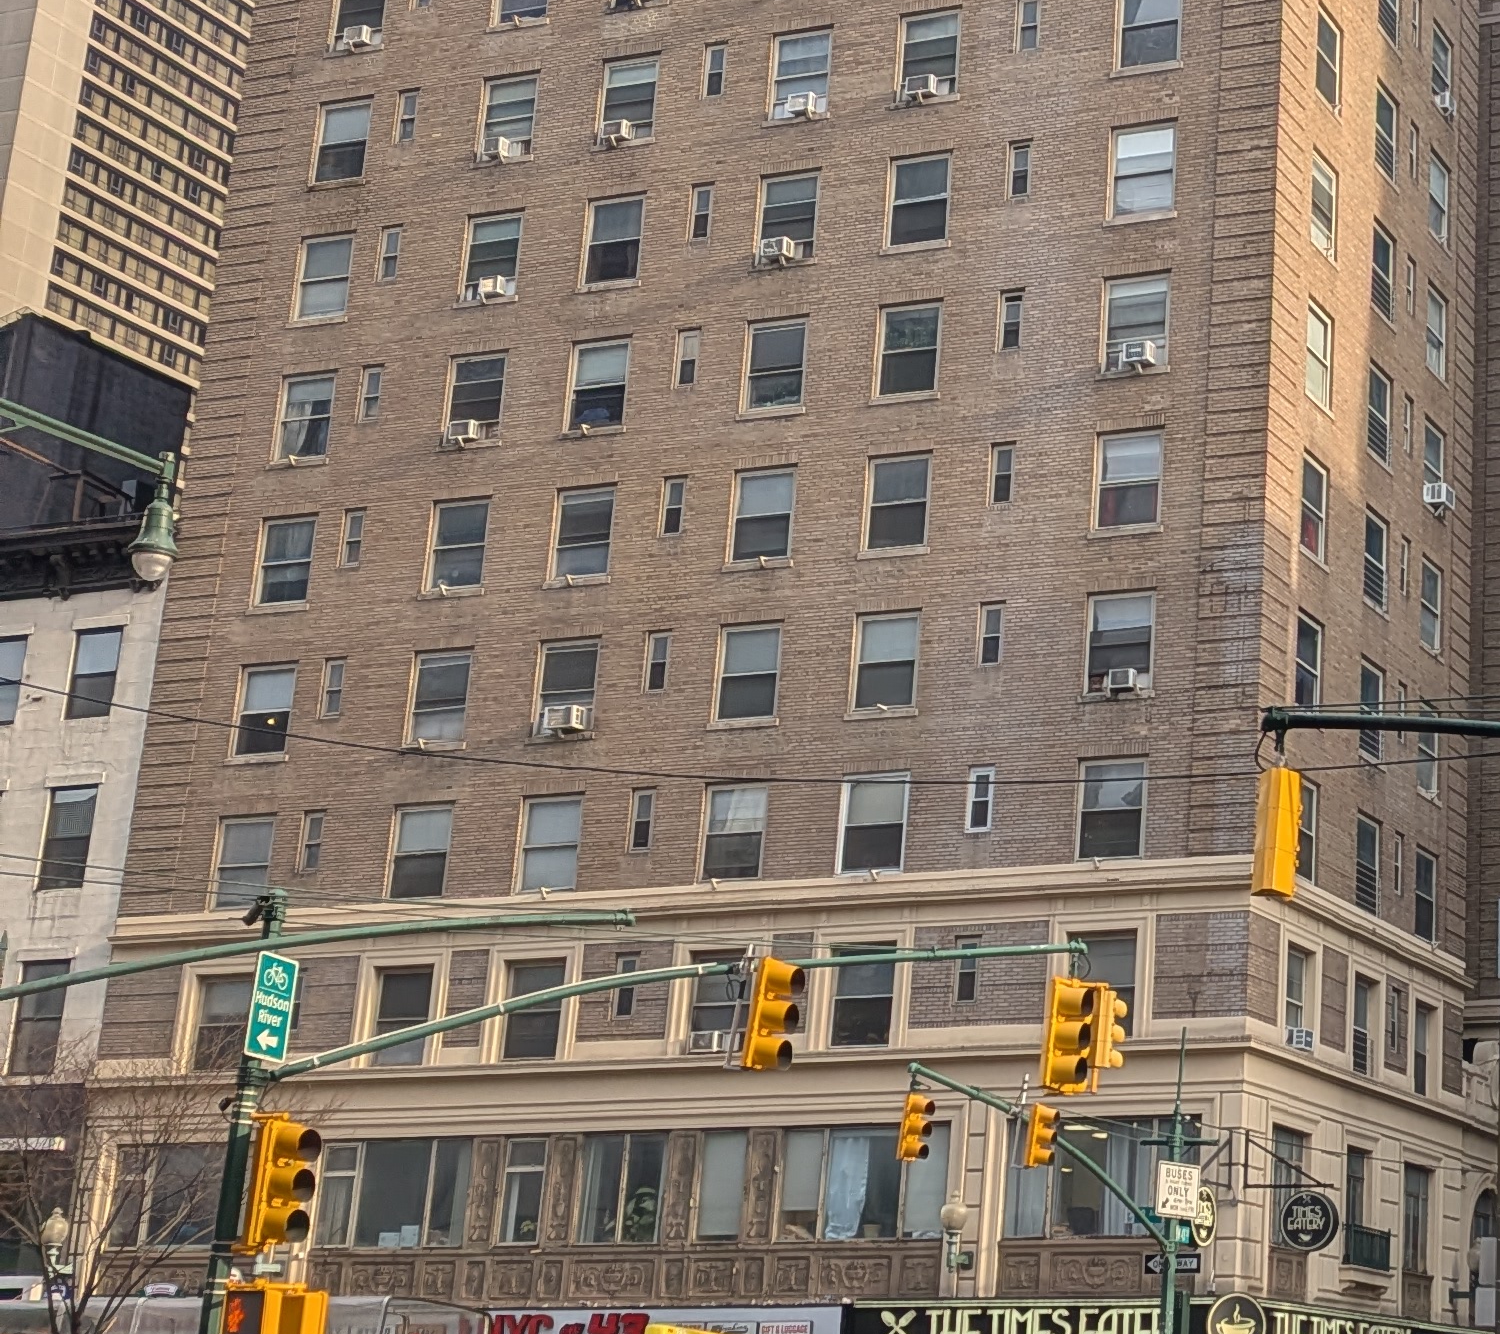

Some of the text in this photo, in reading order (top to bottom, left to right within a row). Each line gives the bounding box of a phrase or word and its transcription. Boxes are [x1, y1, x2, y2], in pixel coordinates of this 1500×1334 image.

[255, 990, 290, 1012] Hudson
[257, 1008, 283, 1028] River
[1165, 1167, 1193, 1181] BUSES
[1167, 1185, 1190, 1197] ONLY
[1292, 1206, 1322, 1218] TIMES
[1287, 1217, 1326, 1231] EATERY
